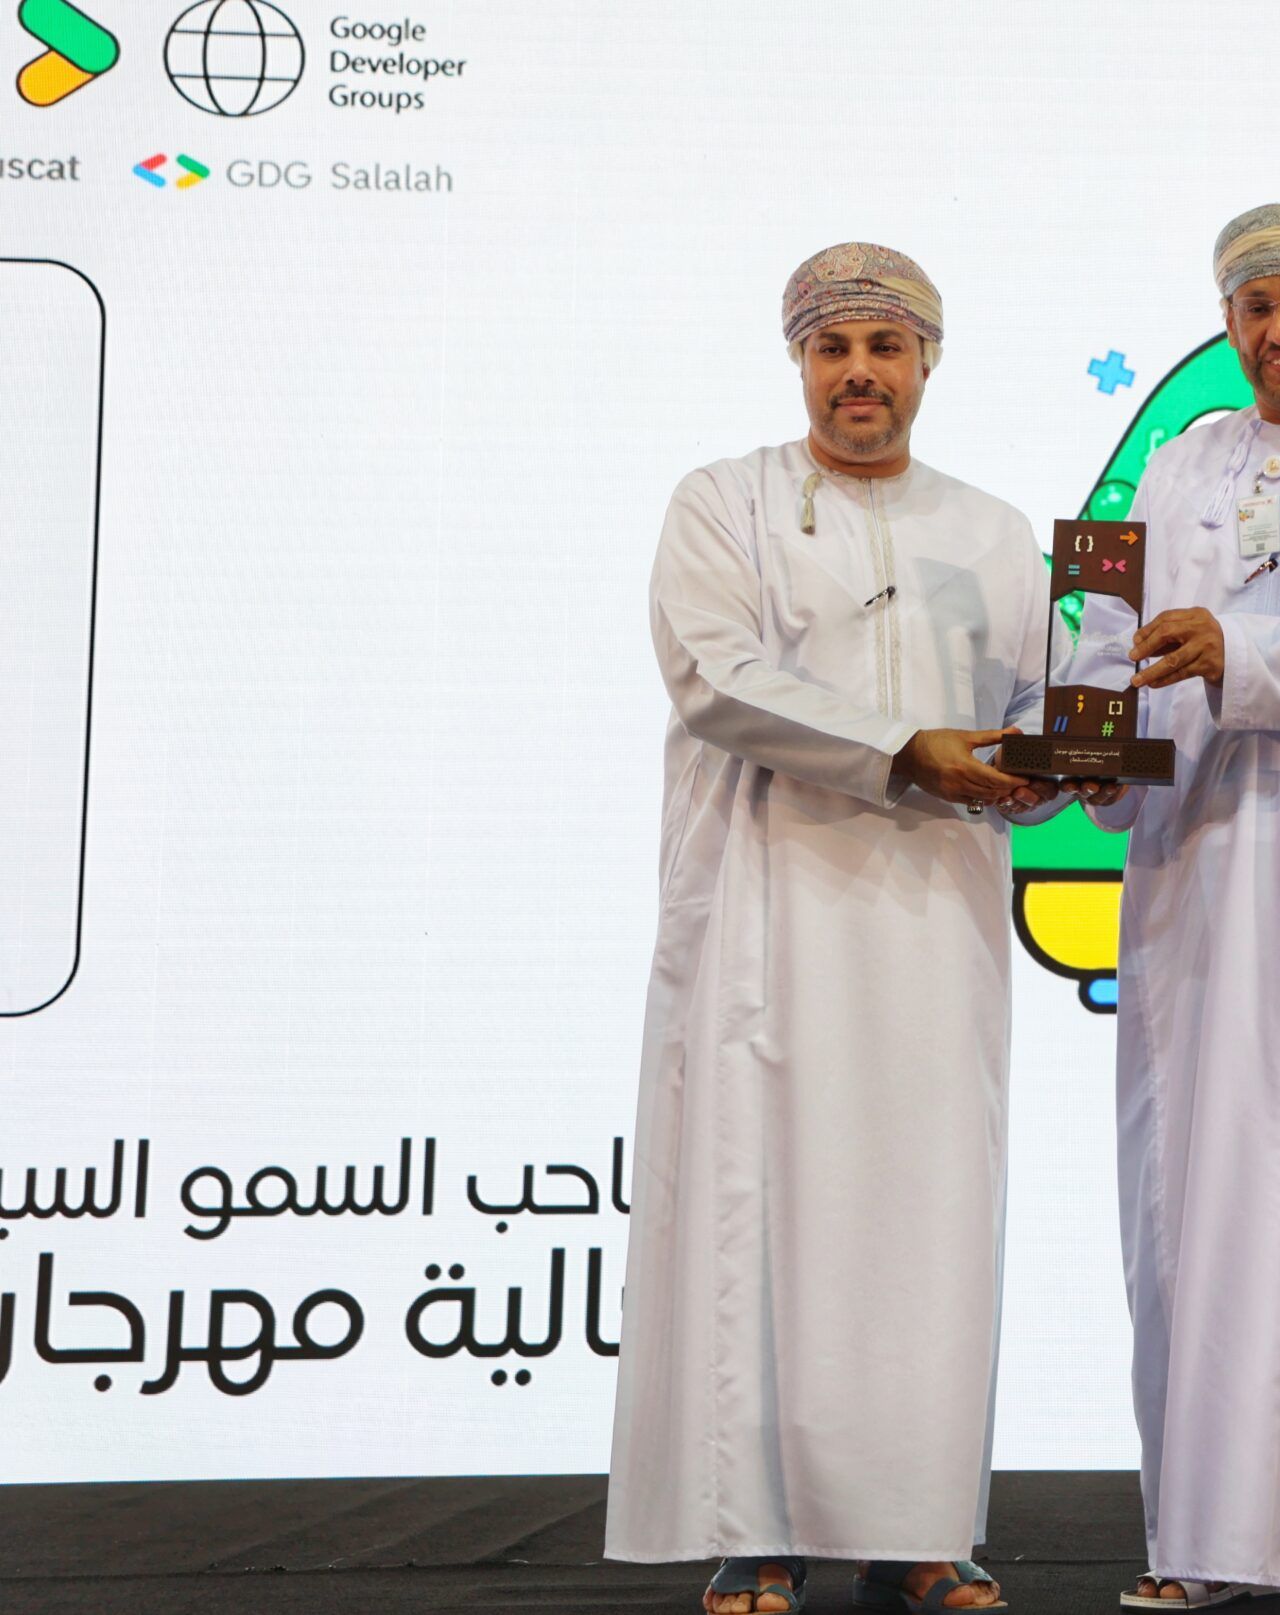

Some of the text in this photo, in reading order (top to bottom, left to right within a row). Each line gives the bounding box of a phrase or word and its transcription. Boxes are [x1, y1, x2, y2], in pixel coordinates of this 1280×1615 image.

[329, 16, 427, 47] Google
[329, 50, 467, 81] Developer
[328, 84, 426, 115] Groups
[0, 155, 80, 181] scat
[226, 159, 454, 192] GDG Salalah
[180, 1137, 436, 1241] السمو
[467, 1136, 630, 1234] احب
[405, 1247, 624, 1386] الية
